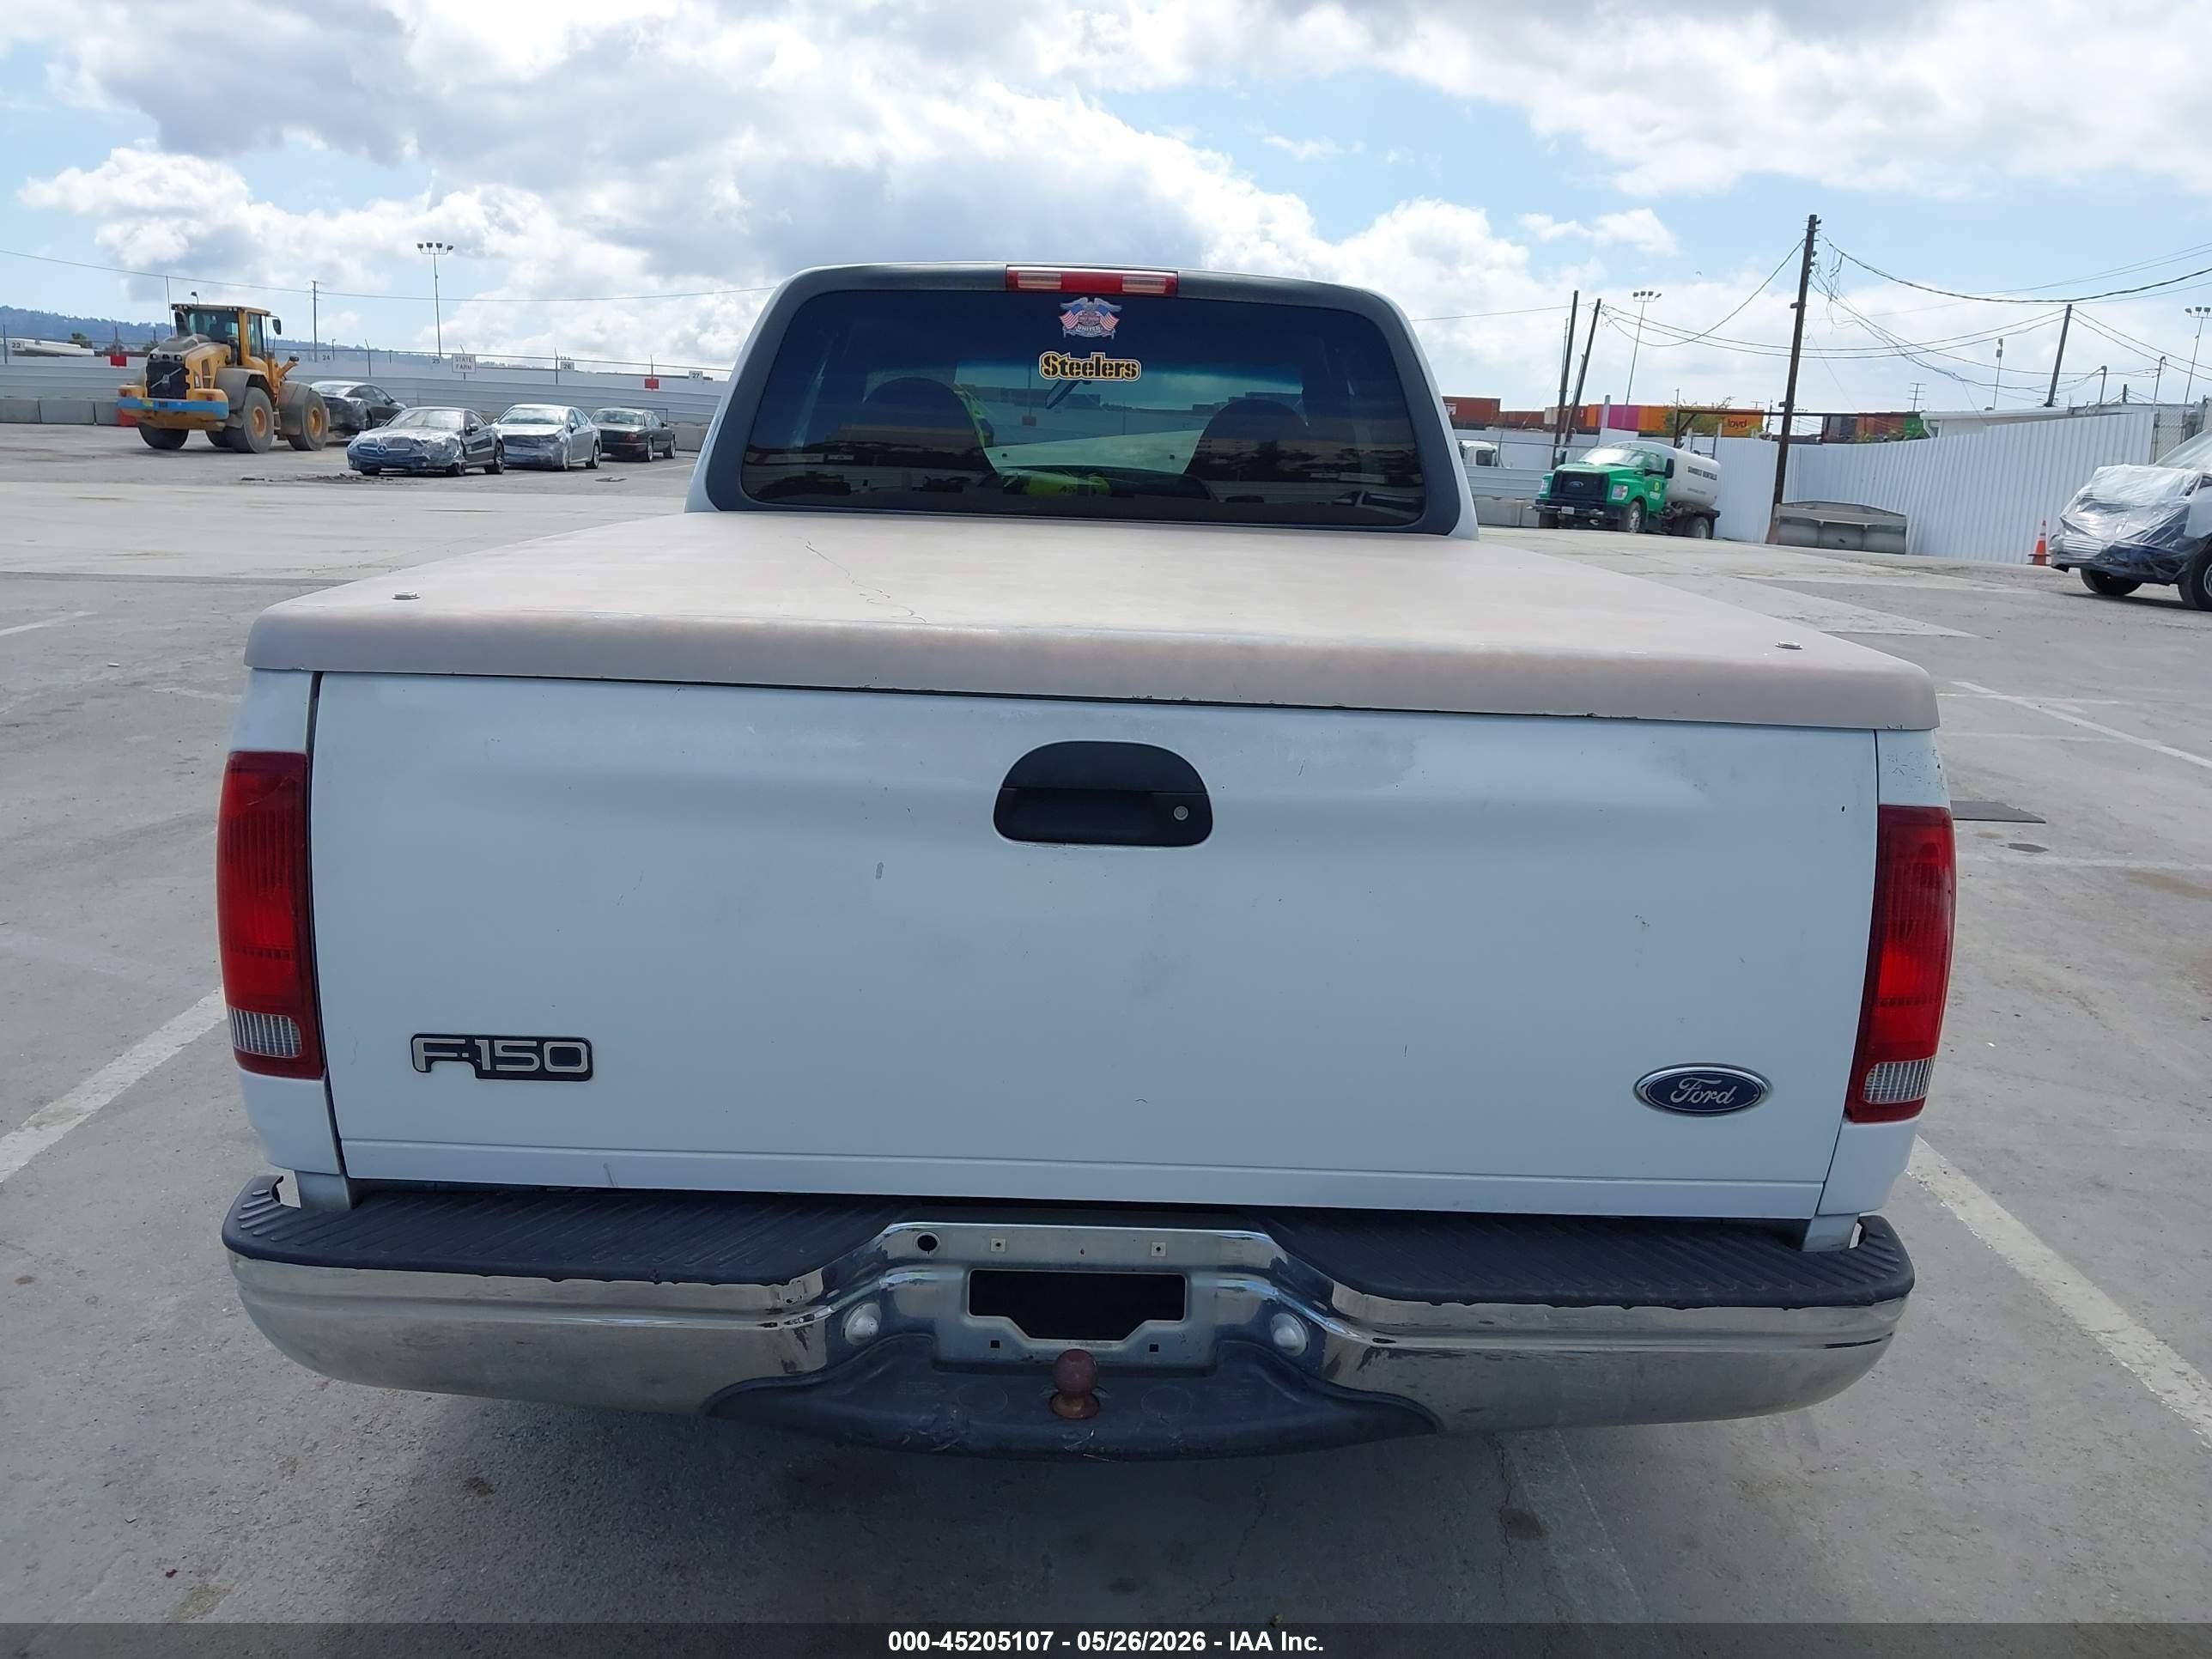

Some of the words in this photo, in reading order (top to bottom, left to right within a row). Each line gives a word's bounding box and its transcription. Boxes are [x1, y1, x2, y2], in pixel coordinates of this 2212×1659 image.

[1041, 352, 1140, 380] Steelers
[412, 1037, 589, 1073] F-150
[1669, 1077, 1737, 1105] Ford
